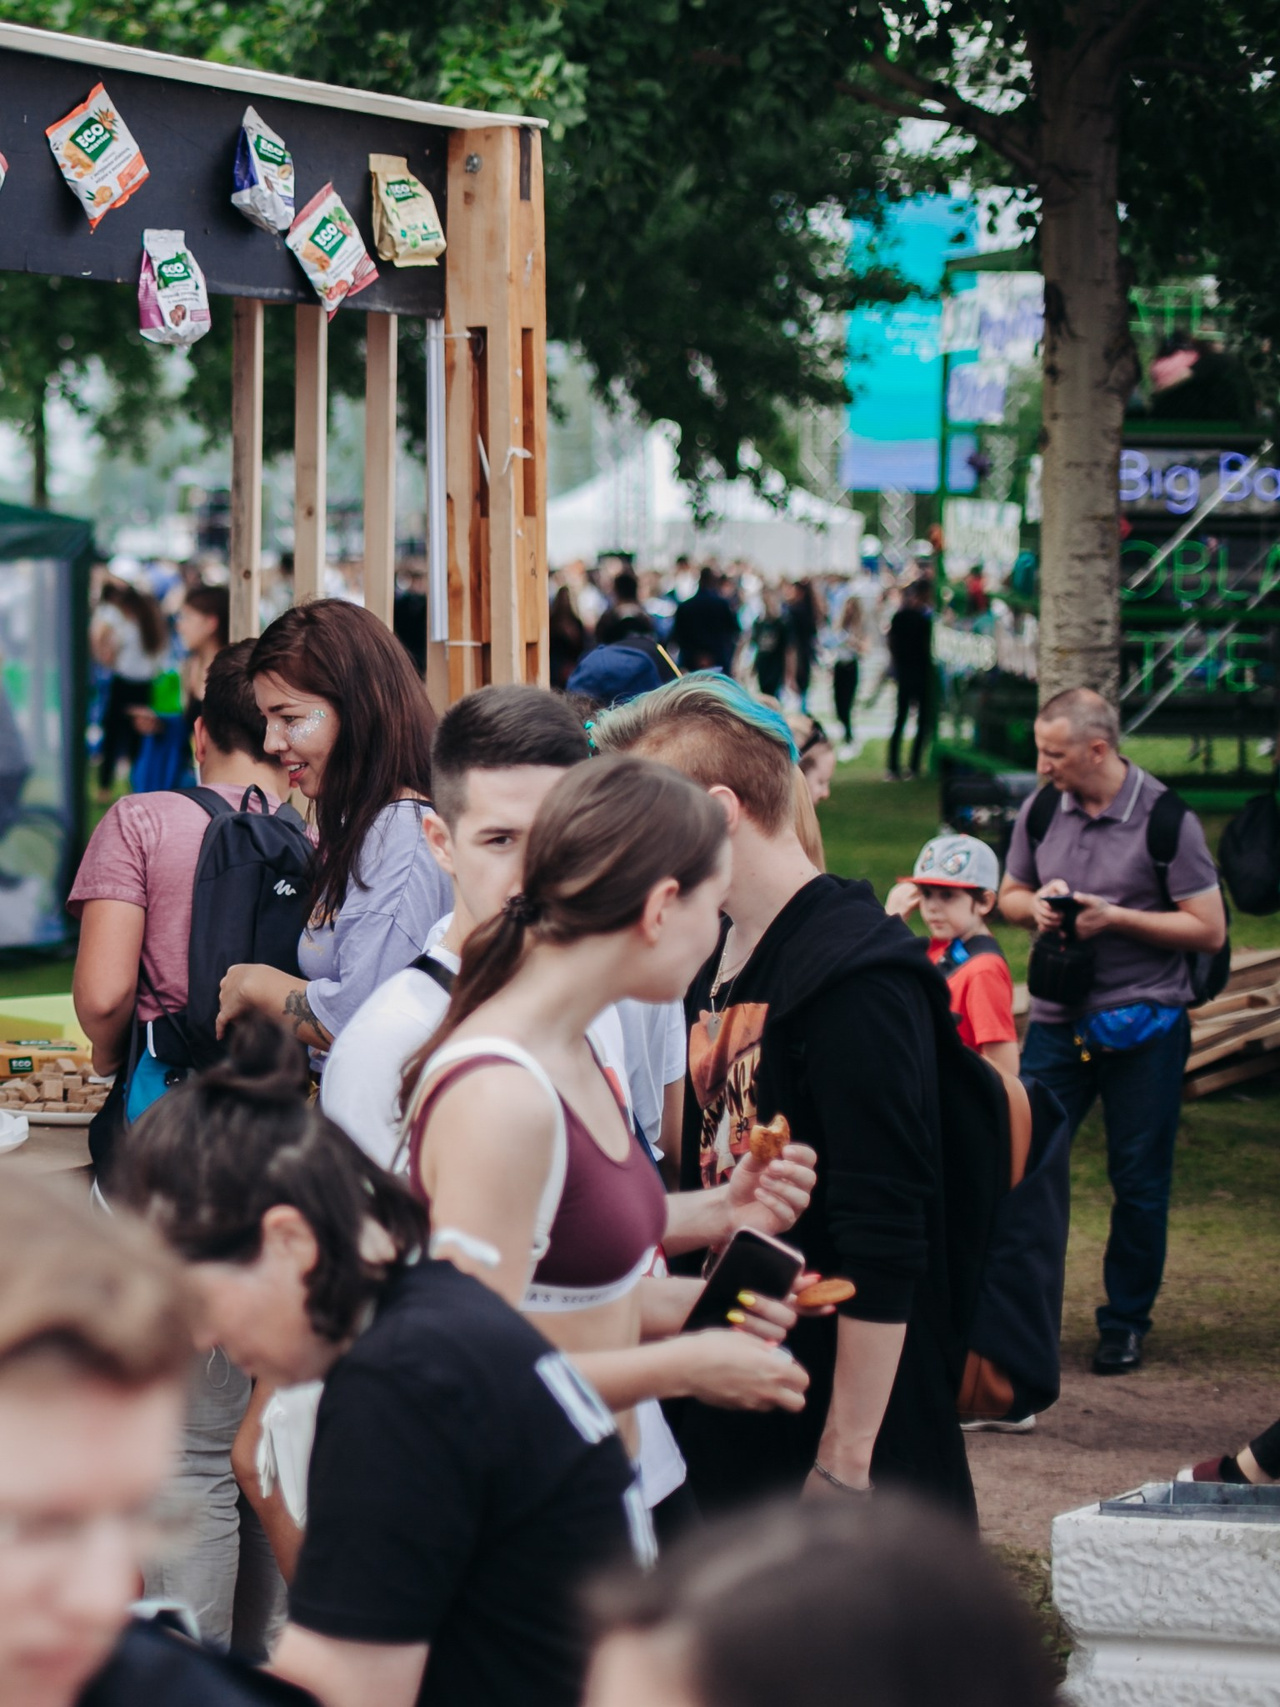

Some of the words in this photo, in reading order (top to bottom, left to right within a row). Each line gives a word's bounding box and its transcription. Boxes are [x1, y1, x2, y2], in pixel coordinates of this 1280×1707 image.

[75, 123, 104, 148] ECO
[314, 223, 338, 246] ECO
[1118, 449, 1200, 515] Big
